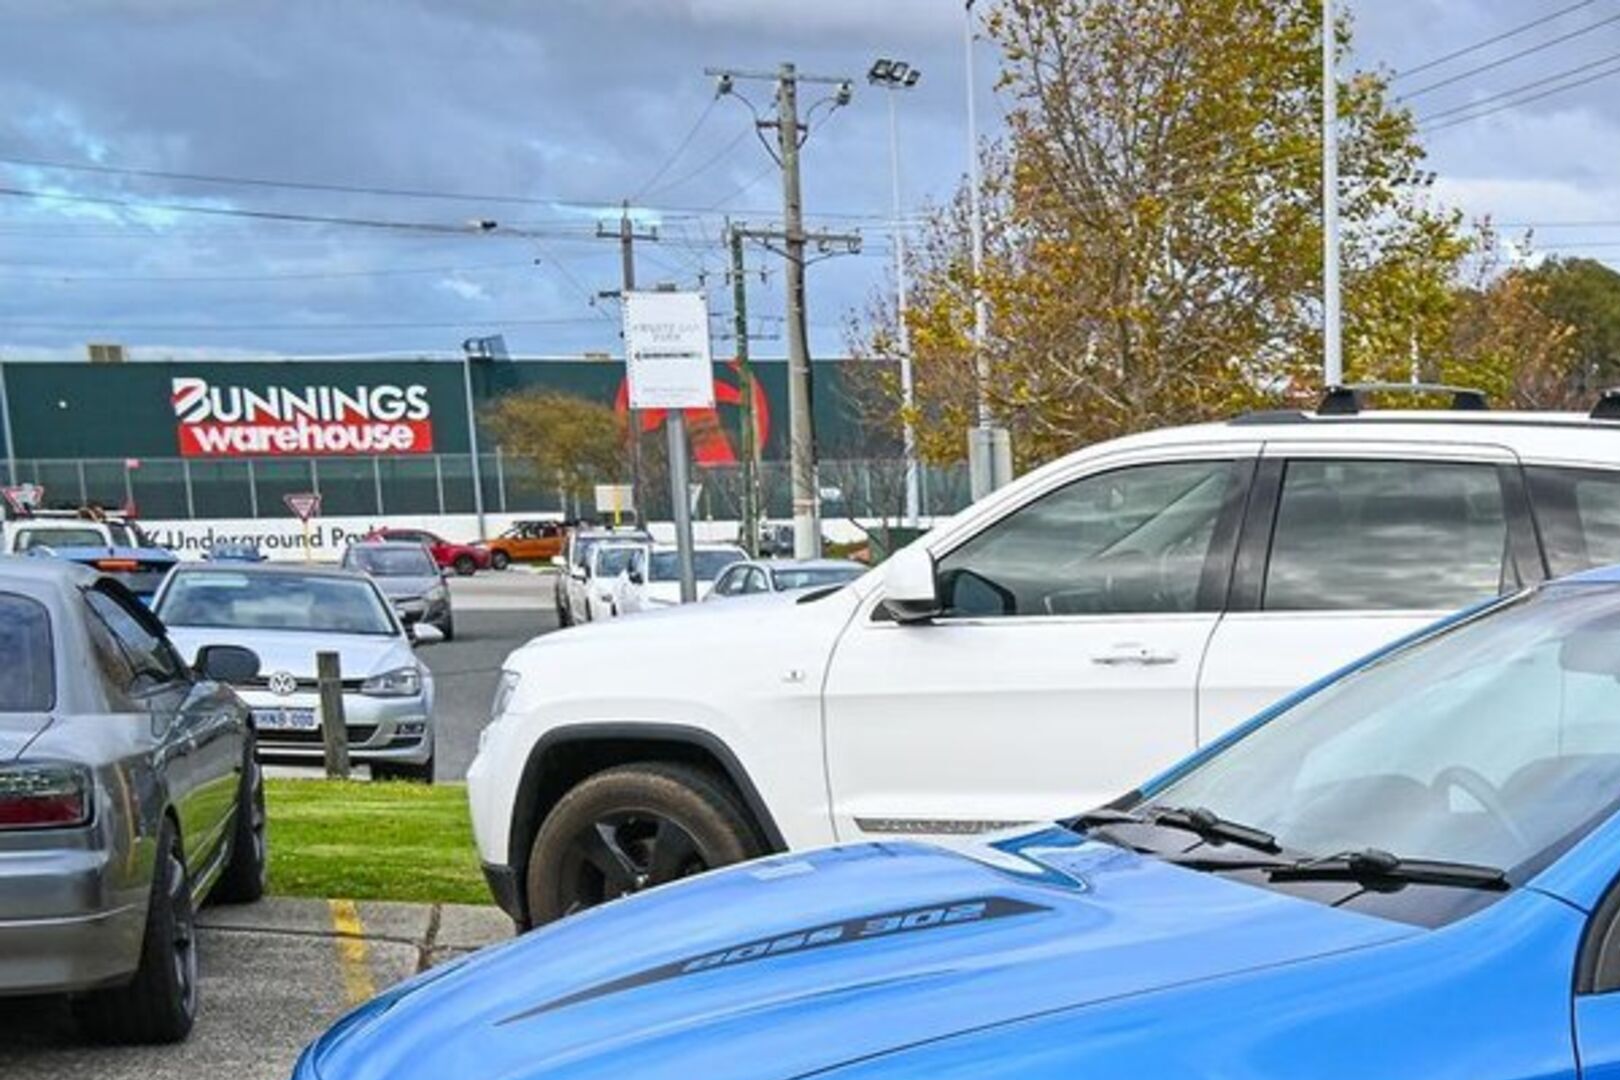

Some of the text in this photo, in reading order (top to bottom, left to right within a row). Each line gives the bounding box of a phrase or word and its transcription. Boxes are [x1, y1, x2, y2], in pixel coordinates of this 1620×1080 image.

[172, 377, 430, 423] BUNNINGS
[191, 412, 415, 453] warehouse
[858, 903, 987, 936] 302
